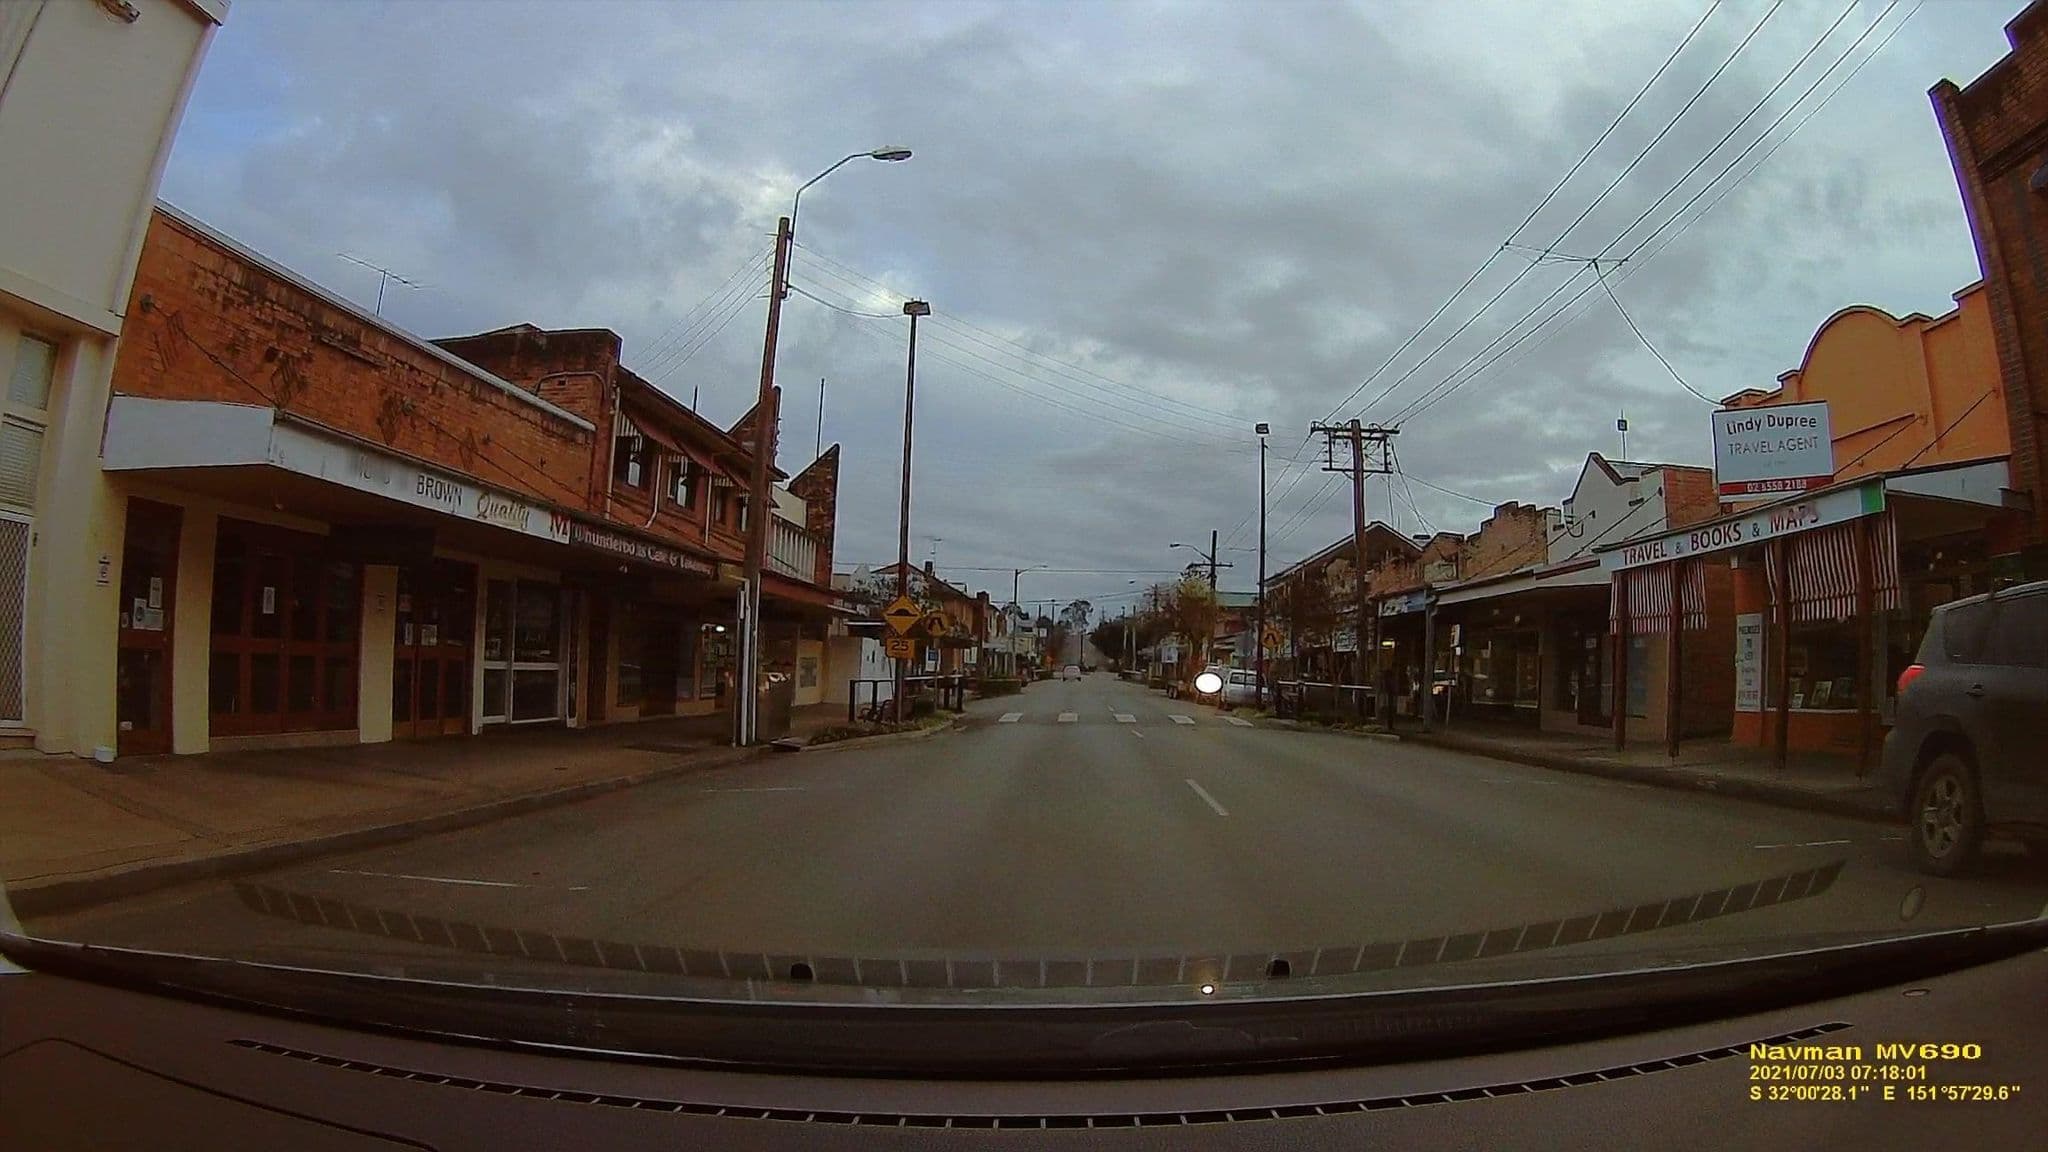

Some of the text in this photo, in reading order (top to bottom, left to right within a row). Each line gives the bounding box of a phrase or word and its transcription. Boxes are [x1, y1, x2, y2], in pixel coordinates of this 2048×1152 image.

[1726, 414, 1818, 435] Lindy Dupree
[1727, 436, 1819, 456] TRAVEL AGENT
[415, 474, 463, 508] BROWN
[476, 492, 531, 530] Quality
[1622, 503, 1820, 565] TRAVEL & BOOKS & MAPS
[892, 640, 909, 651] 25
